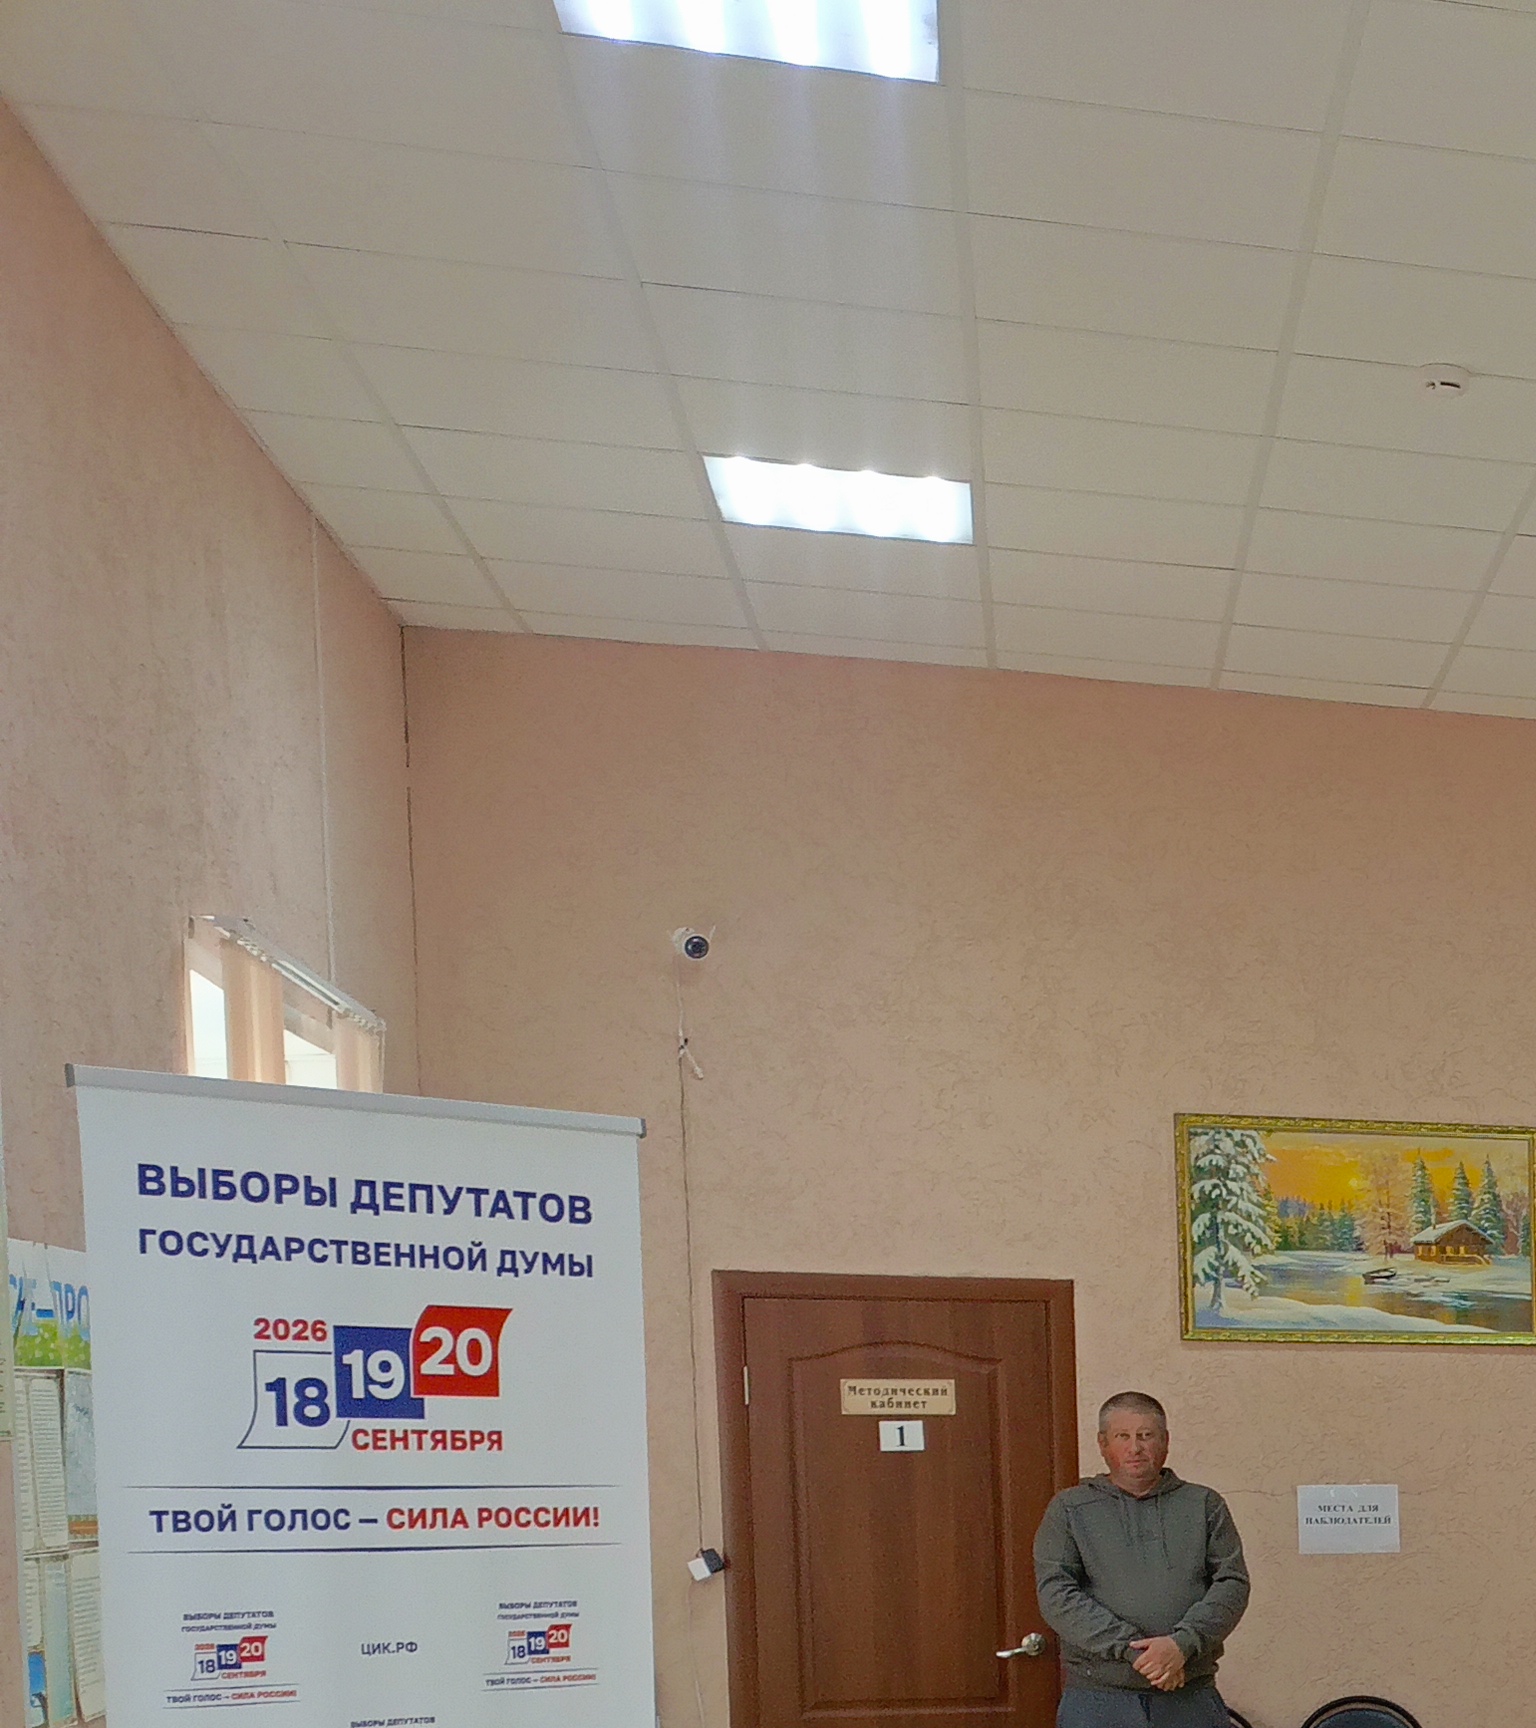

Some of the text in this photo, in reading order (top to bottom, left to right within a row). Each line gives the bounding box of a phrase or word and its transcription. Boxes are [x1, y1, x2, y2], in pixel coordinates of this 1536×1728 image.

[138, 1163, 593, 1225] ВЫБОРЫ ДЕПУТАТОВ
[138, 1229, 593, 1279] ГОСУДАРСТВЕННОЙ ДУМЫ
[253, 1318, 328, 1342] 2026
[265, 1327, 492, 1427] 18 19 20
[848, 1385, 948, 1398] Методический
[870, 1398, 928, 1409] кабинет
[351, 1429, 503, 1452] СЕНТЯБРЯ
[896, 1425, 908, 1447] 1
[149, 1503, 238, 1533] ТВОЙ
[247, 1507, 351, 1532] ГОЛОС
[387, 1508, 469, 1530] СИЛА
[478, 1507, 600, 1529] РОССИИ!
[1305, 1515, 1391, 1525] НАБЛЮДАТЕЛЕЙ
[1318, 1505, 1379, 1513] МЕСТА ДЛЯ
[361, 1641, 418, 1656] ЦИК.РФ
[511, 1629, 567, 1658] 18 19 20
[198, 1642, 262, 1673] 18 19 20
